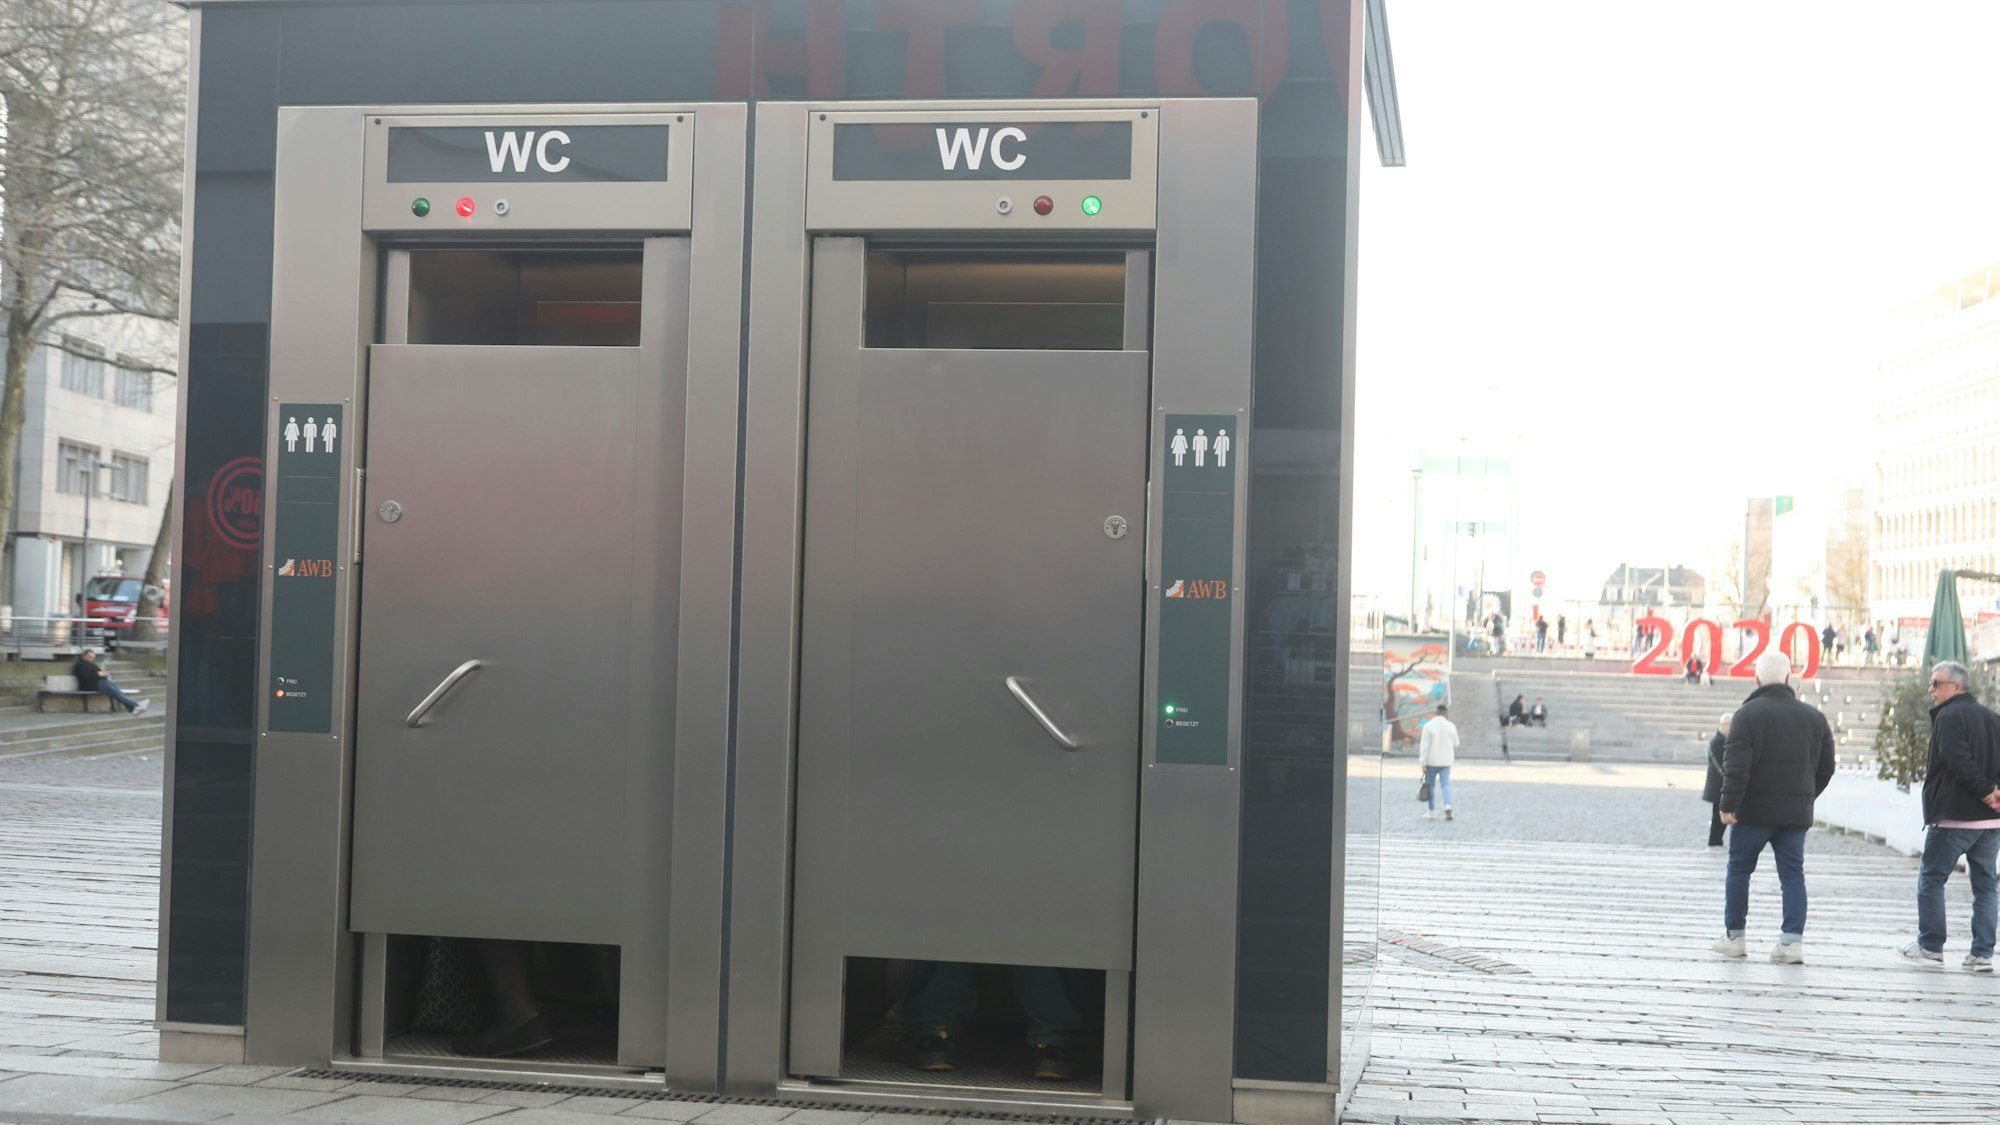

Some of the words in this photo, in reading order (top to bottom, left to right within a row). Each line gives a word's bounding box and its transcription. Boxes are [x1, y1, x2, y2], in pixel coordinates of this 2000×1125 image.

[485, 130, 571, 173] WC
[936, 127, 1027, 171] WC
[297, 559, 333, 577] AWB
[1186, 579, 1227, 599] AWB
[1632, 611, 1820, 679] 2020
